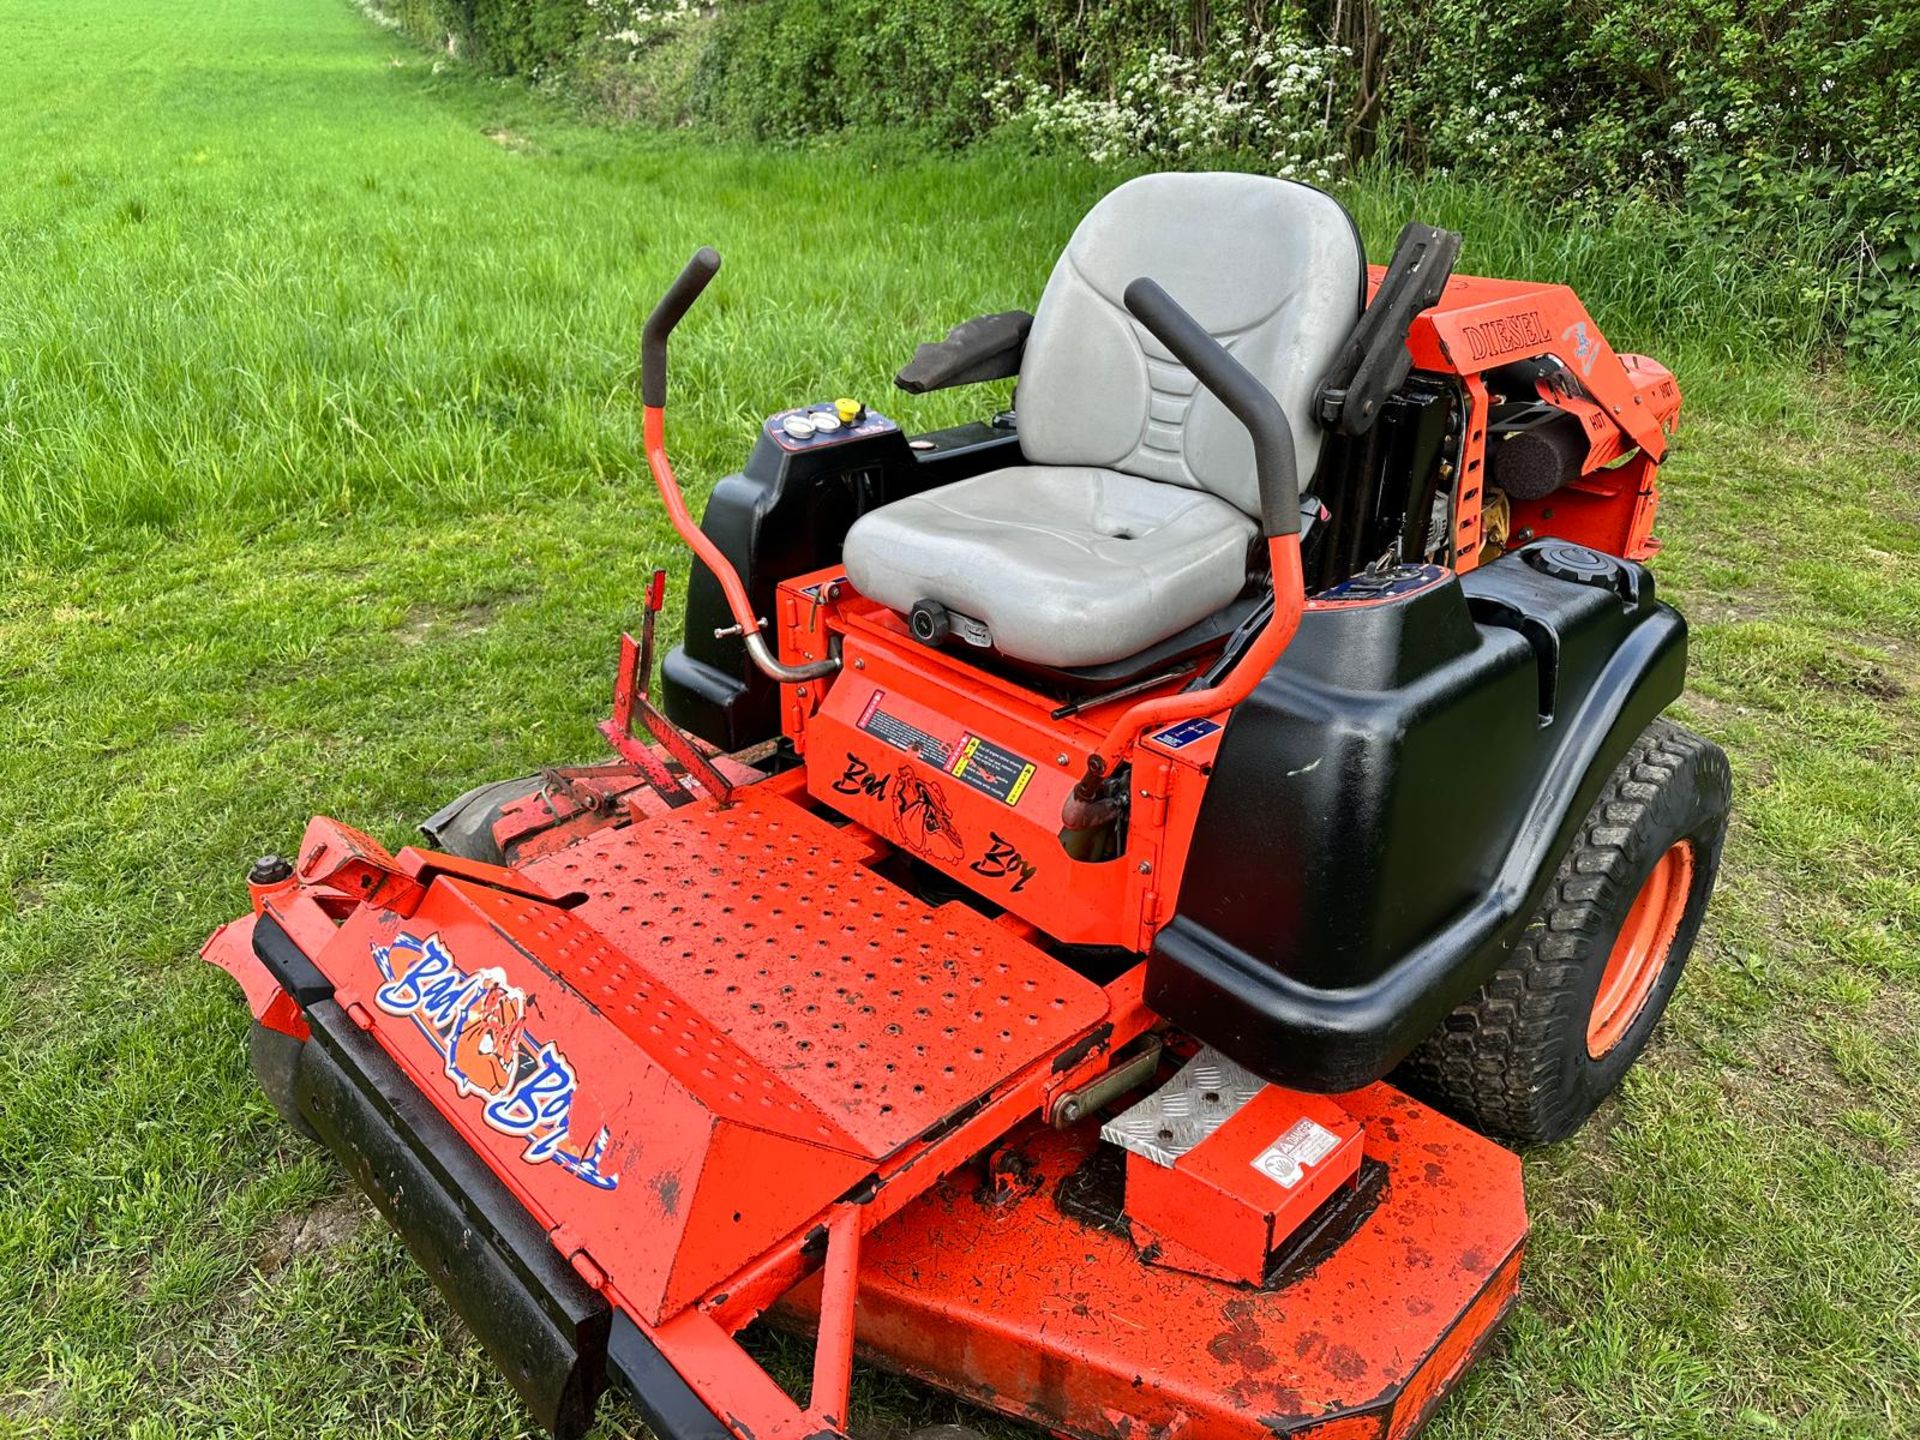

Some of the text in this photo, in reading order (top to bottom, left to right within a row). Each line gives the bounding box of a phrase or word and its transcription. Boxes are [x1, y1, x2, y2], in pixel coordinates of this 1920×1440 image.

[1463, 312, 1552, 360] DIESEL
[1659, 381, 1674, 399] HOT
[1589, 412, 1606, 431] HOT
[832, 752, 892, 802] Bad
[970, 832, 1038, 892] Boy
[379, 939, 476, 1021] Bad
